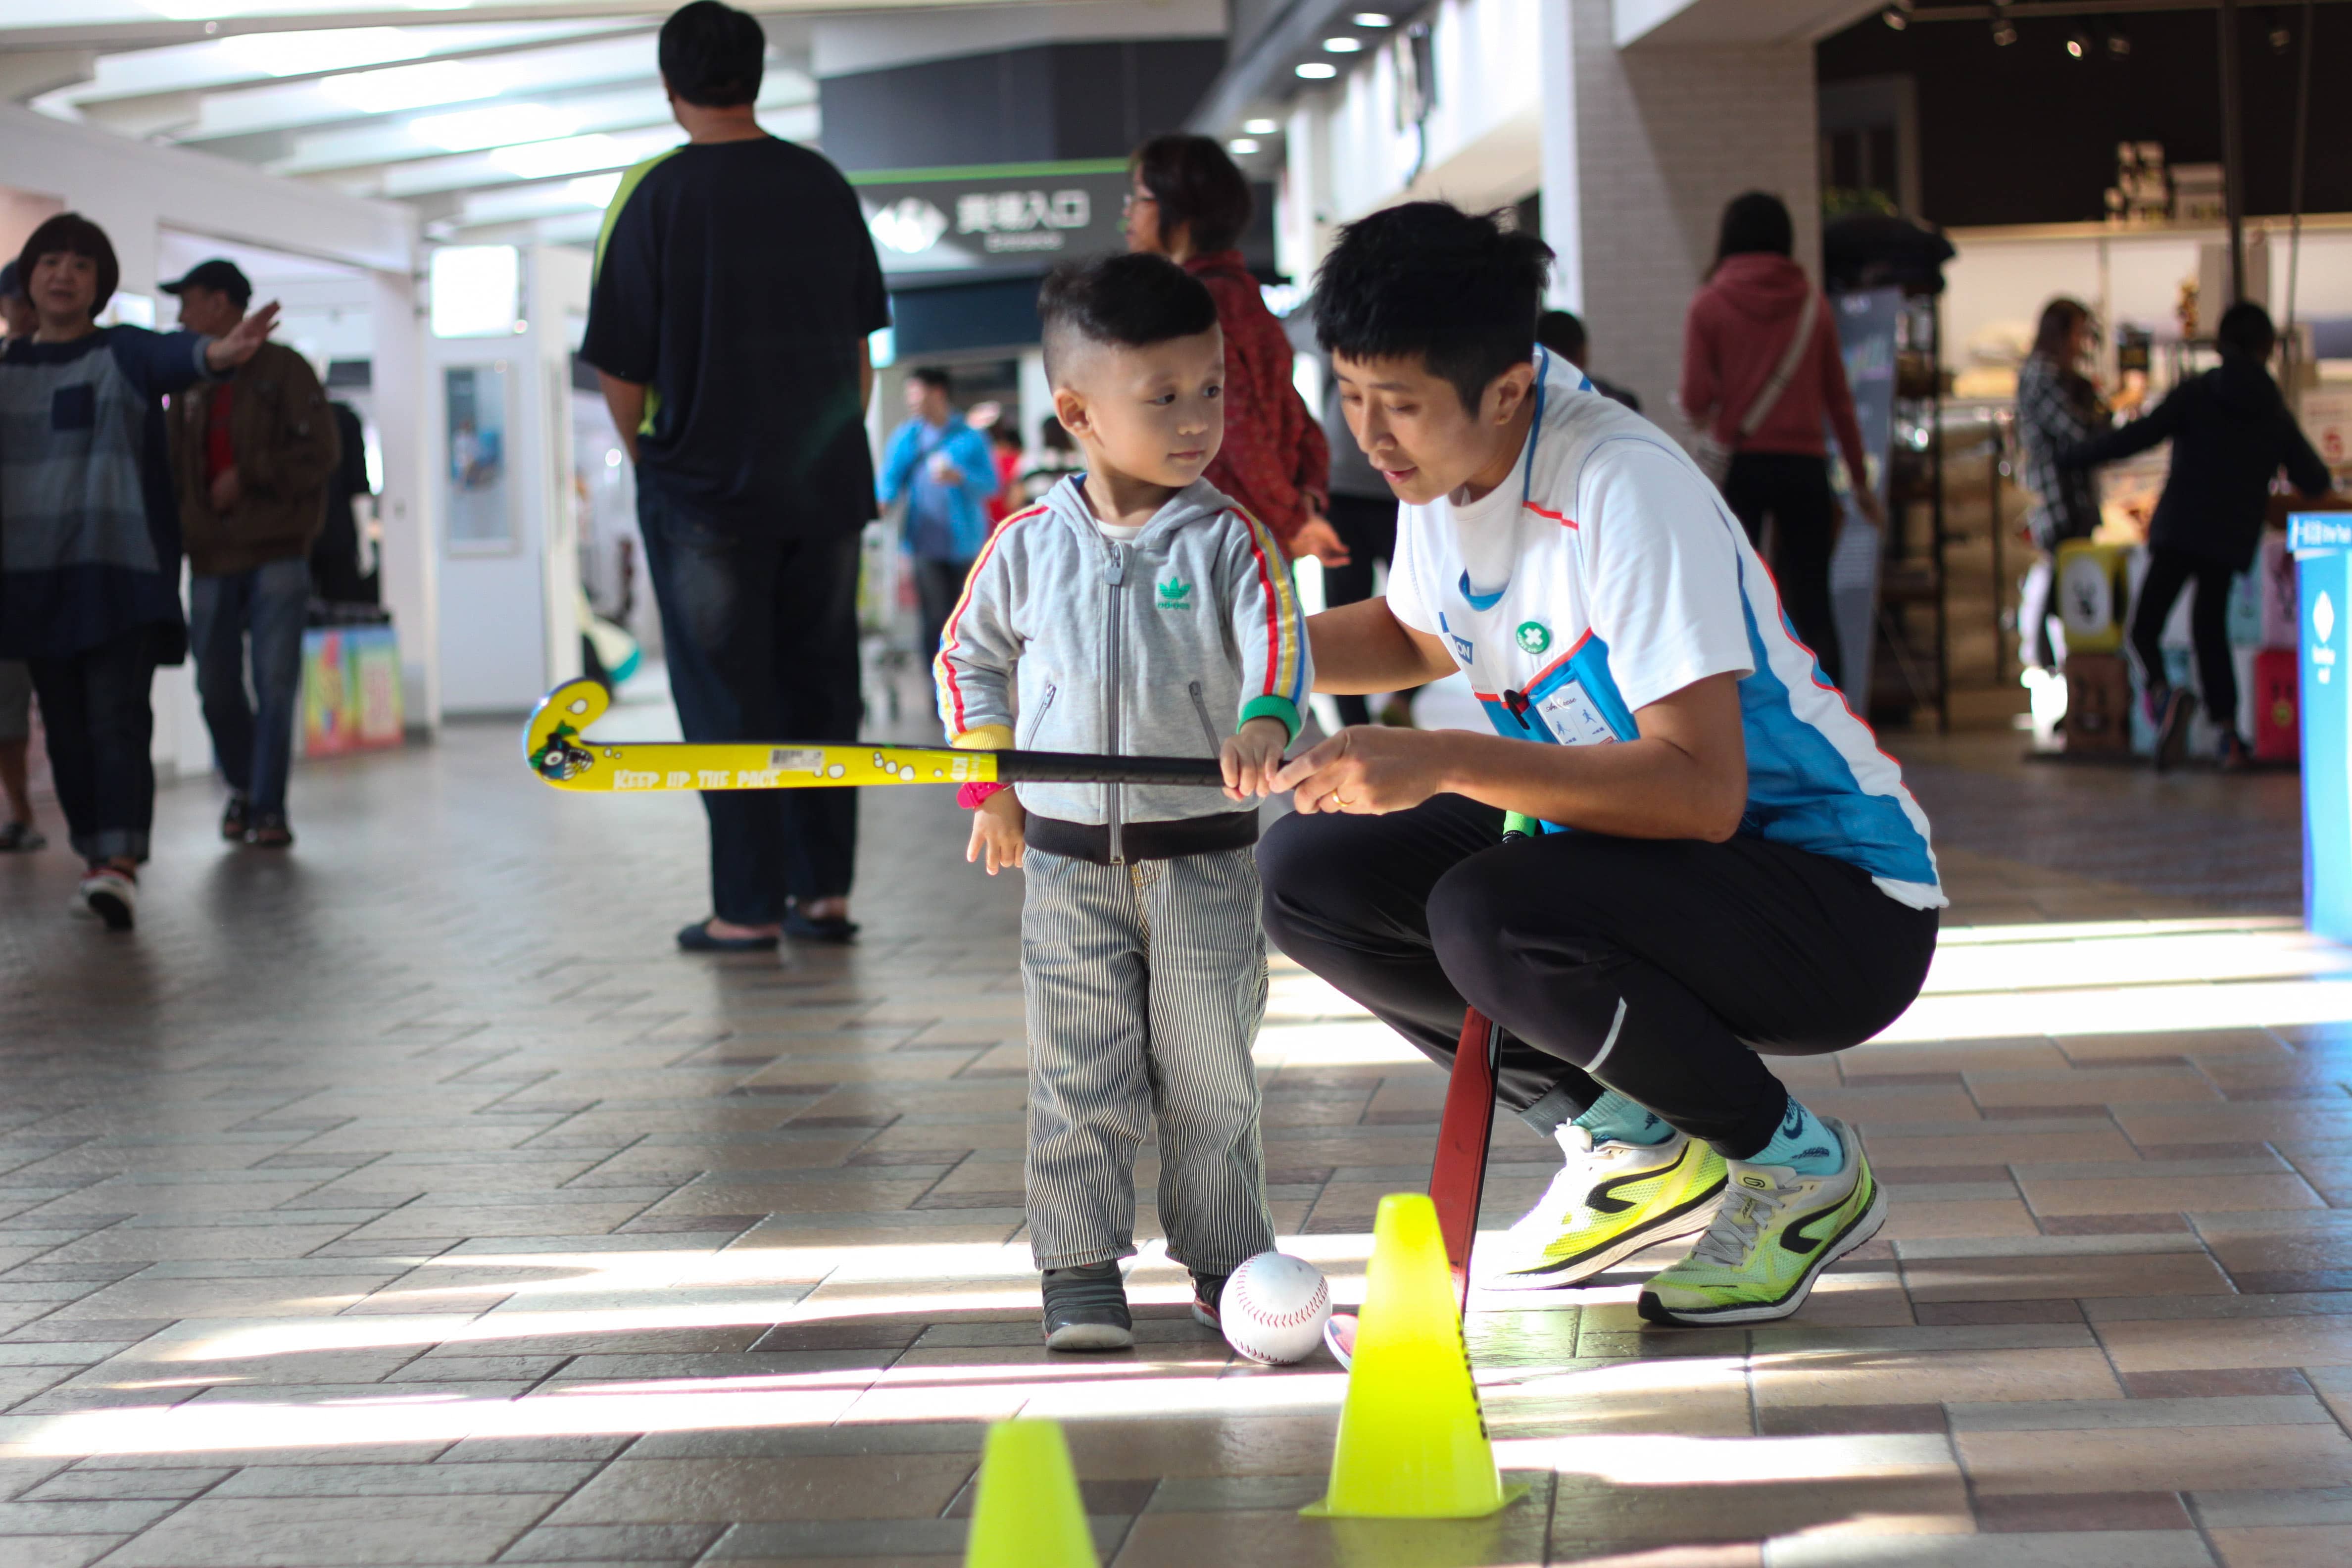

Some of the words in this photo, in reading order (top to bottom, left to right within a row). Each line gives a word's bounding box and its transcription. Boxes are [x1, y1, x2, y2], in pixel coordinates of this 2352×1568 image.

[613, 769, 659, 788] KEEP
[666, 771, 690, 788] UP
[697, 770, 730, 787] THE
[736, 769, 781, 787] PACE
